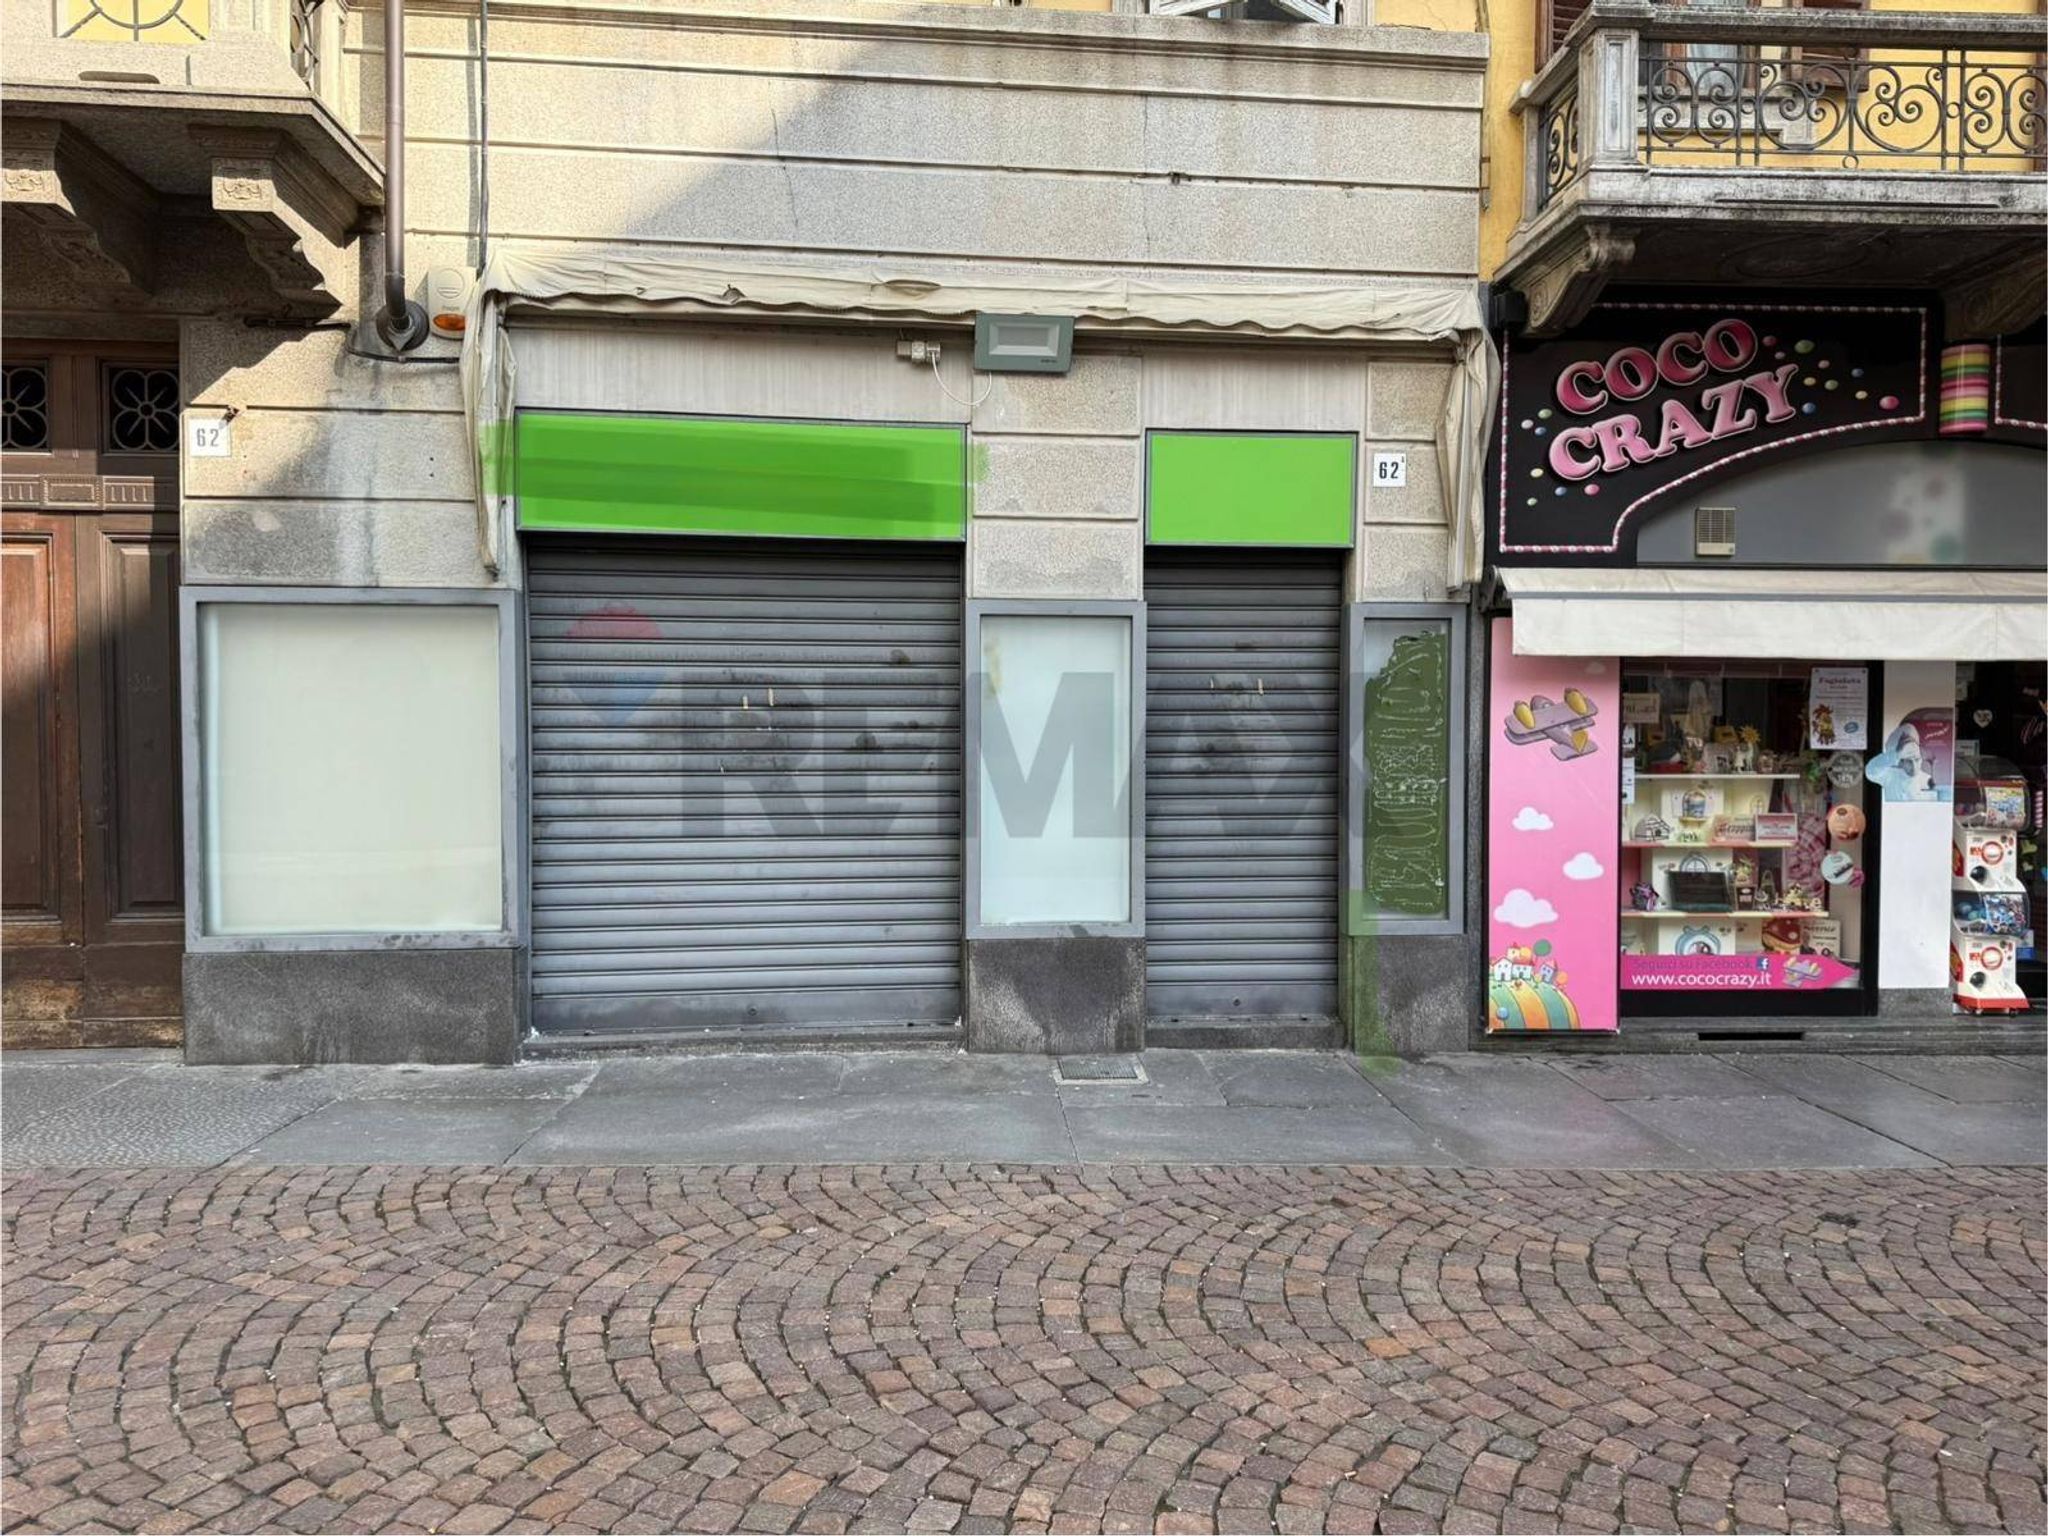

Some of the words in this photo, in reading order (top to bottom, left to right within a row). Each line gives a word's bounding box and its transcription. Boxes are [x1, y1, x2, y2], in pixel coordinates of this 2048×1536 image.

[1556, 318, 1759, 415] COCO
[196, 427, 219, 447] 62
[1549, 363, 1799, 481] CRAZY
[1632, 971, 1772, 988] www.cococrazy.it
